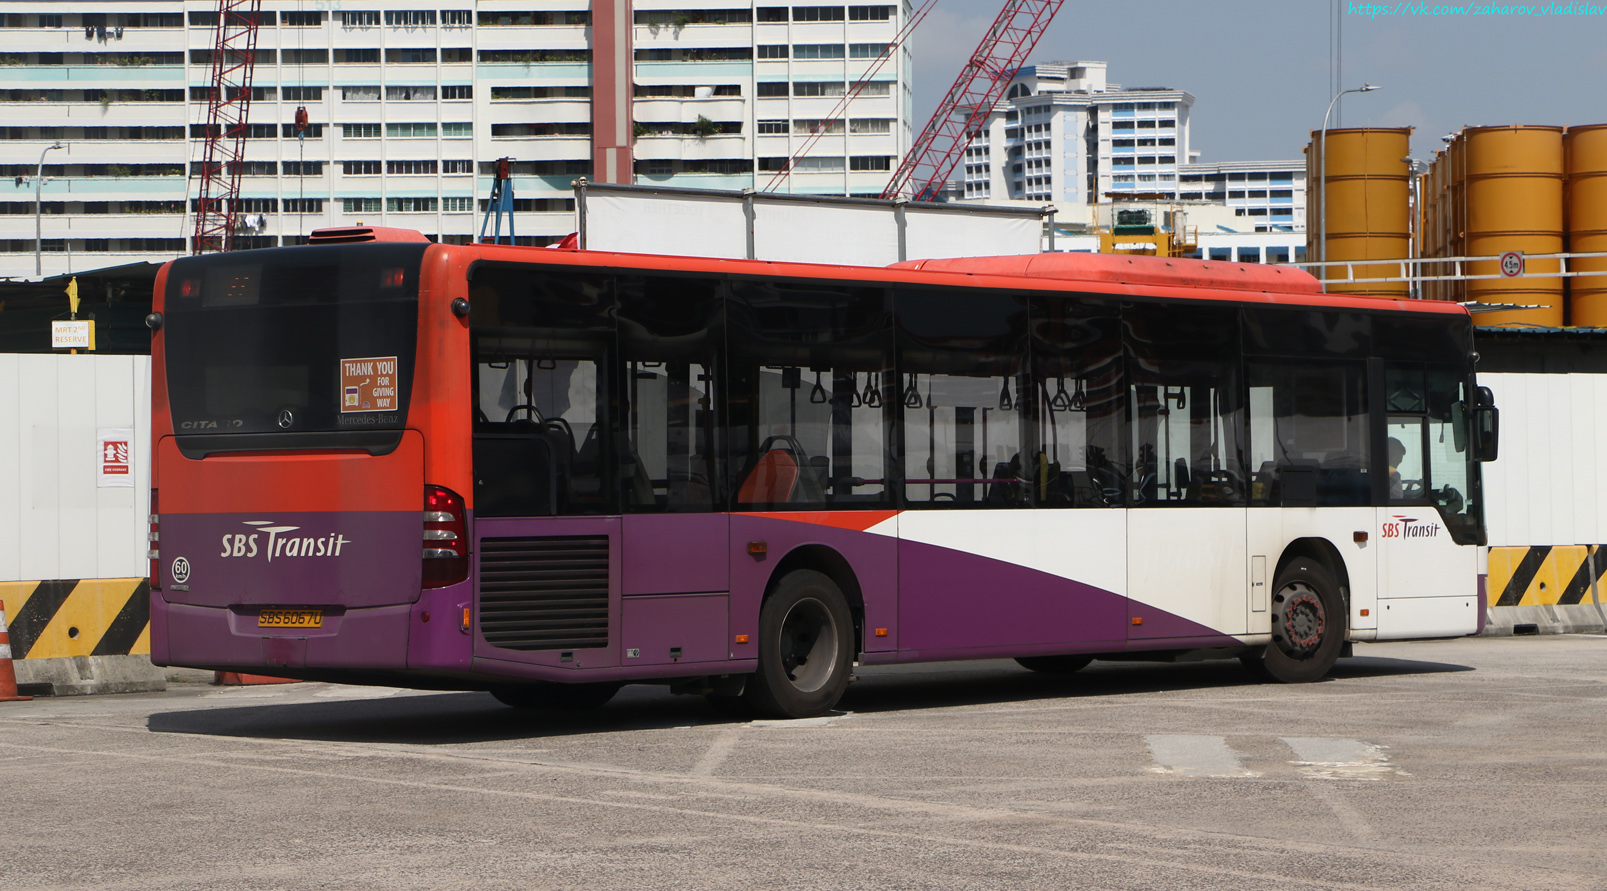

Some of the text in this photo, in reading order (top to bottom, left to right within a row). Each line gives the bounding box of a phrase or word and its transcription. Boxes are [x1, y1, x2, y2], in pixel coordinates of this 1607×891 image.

[315, 0, 342, 11] 513
[55, 326, 72, 334] MRT
[55, 335, 87, 343] RESERVE
[344, 361, 394, 377] THANK YOU
[377, 376, 390, 387] FOR
[372, 387, 394, 397] GIVING
[376, 397, 391, 408] WAY
[336, 413, 399, 426] Mercedes-Benz
[1381, 518, 1441, 541] SBS Transit
[220, 525, 352, 563] SBS Transit
[175, 561, 187, 574] 60
[259, 611, 323, 625] SBS6067U
